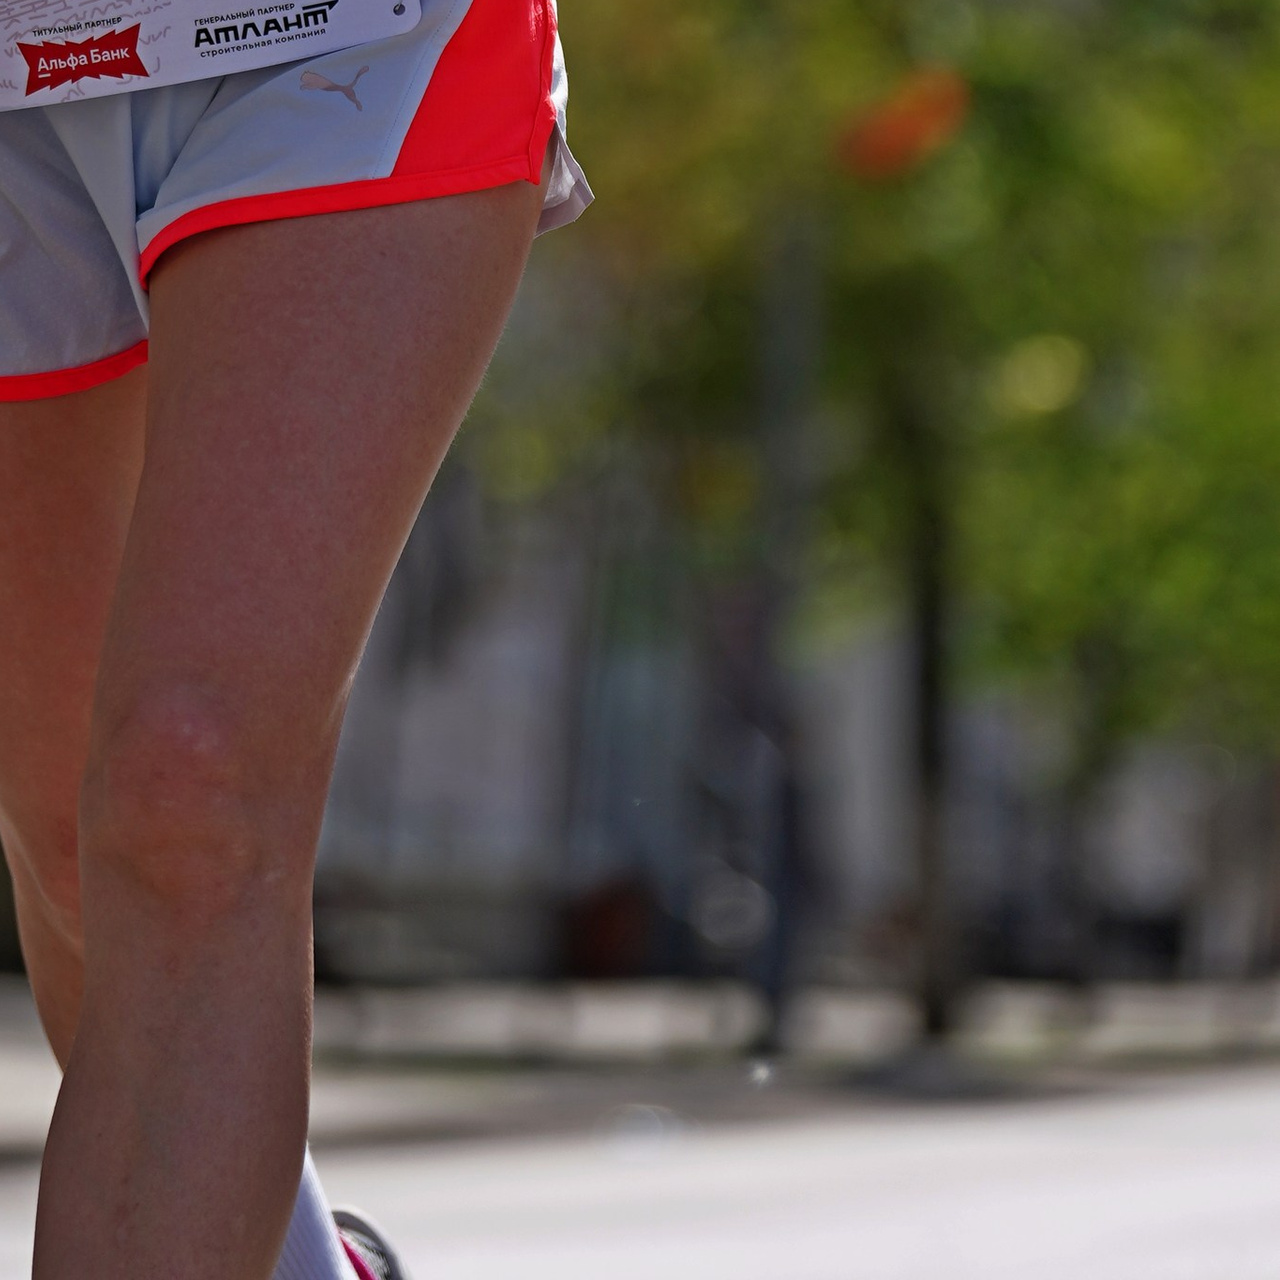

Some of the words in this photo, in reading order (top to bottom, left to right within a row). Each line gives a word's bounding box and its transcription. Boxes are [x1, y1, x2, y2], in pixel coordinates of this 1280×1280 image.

[32, 22, 83, 37] ТИТУЛЬНЫЙ
[84, 16, 123, 30] ПАРТНЕР
[194, 8, 255, 27] ГЕНЕРАЛЬНЫЙ
[257, 3, 296, 16] ПАРТНЕР
[200, 39, 273, 58] строительная
[274, 28, 327, 44] компания
[37, 52, 89, 73] Альфа
[90, 47, 131, 64] Банк
